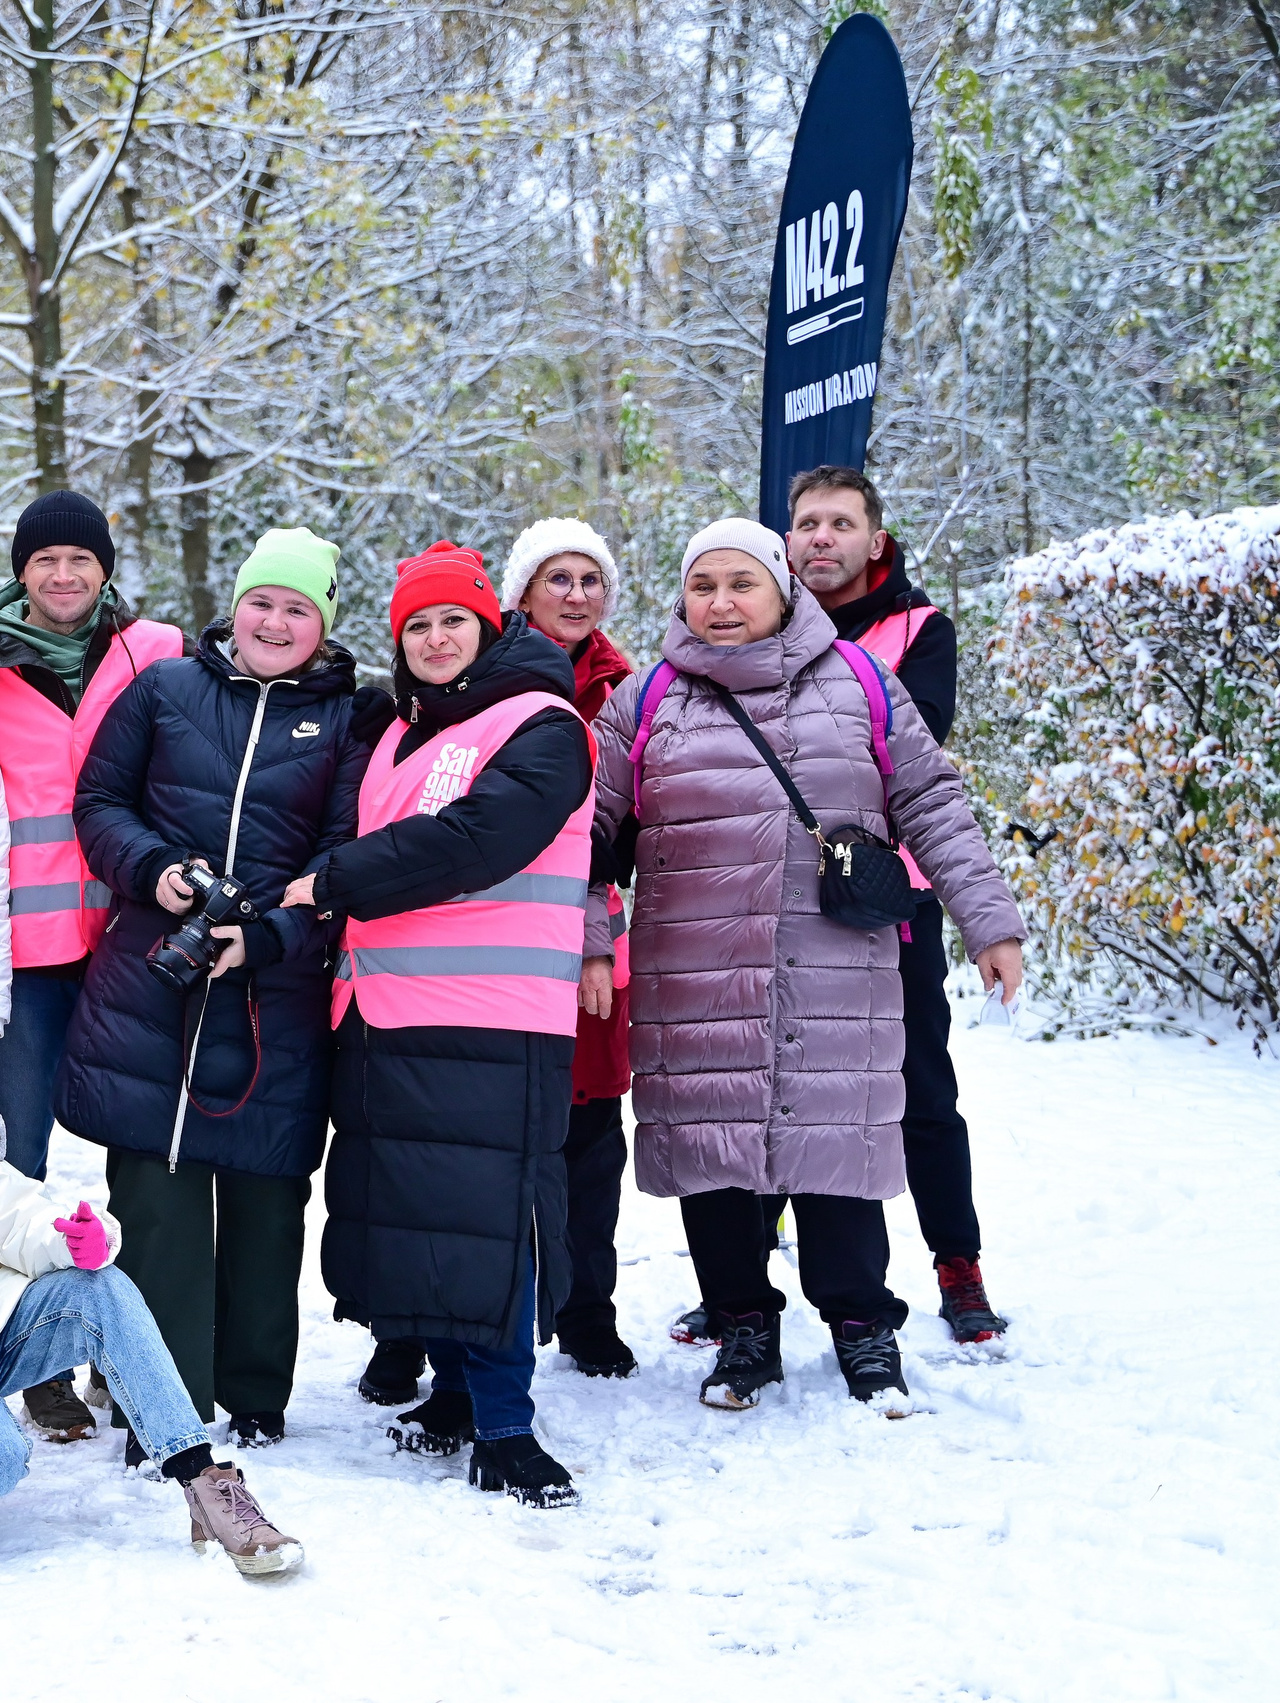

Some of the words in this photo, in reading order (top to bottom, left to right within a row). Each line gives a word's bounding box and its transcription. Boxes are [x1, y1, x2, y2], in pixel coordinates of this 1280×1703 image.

[786, 189, 864, 315] M42.2
[785, 381, 824, 425] MISSION
[299, 721, 320, 733] NIK
[432, 743, 479, 779] Sat
